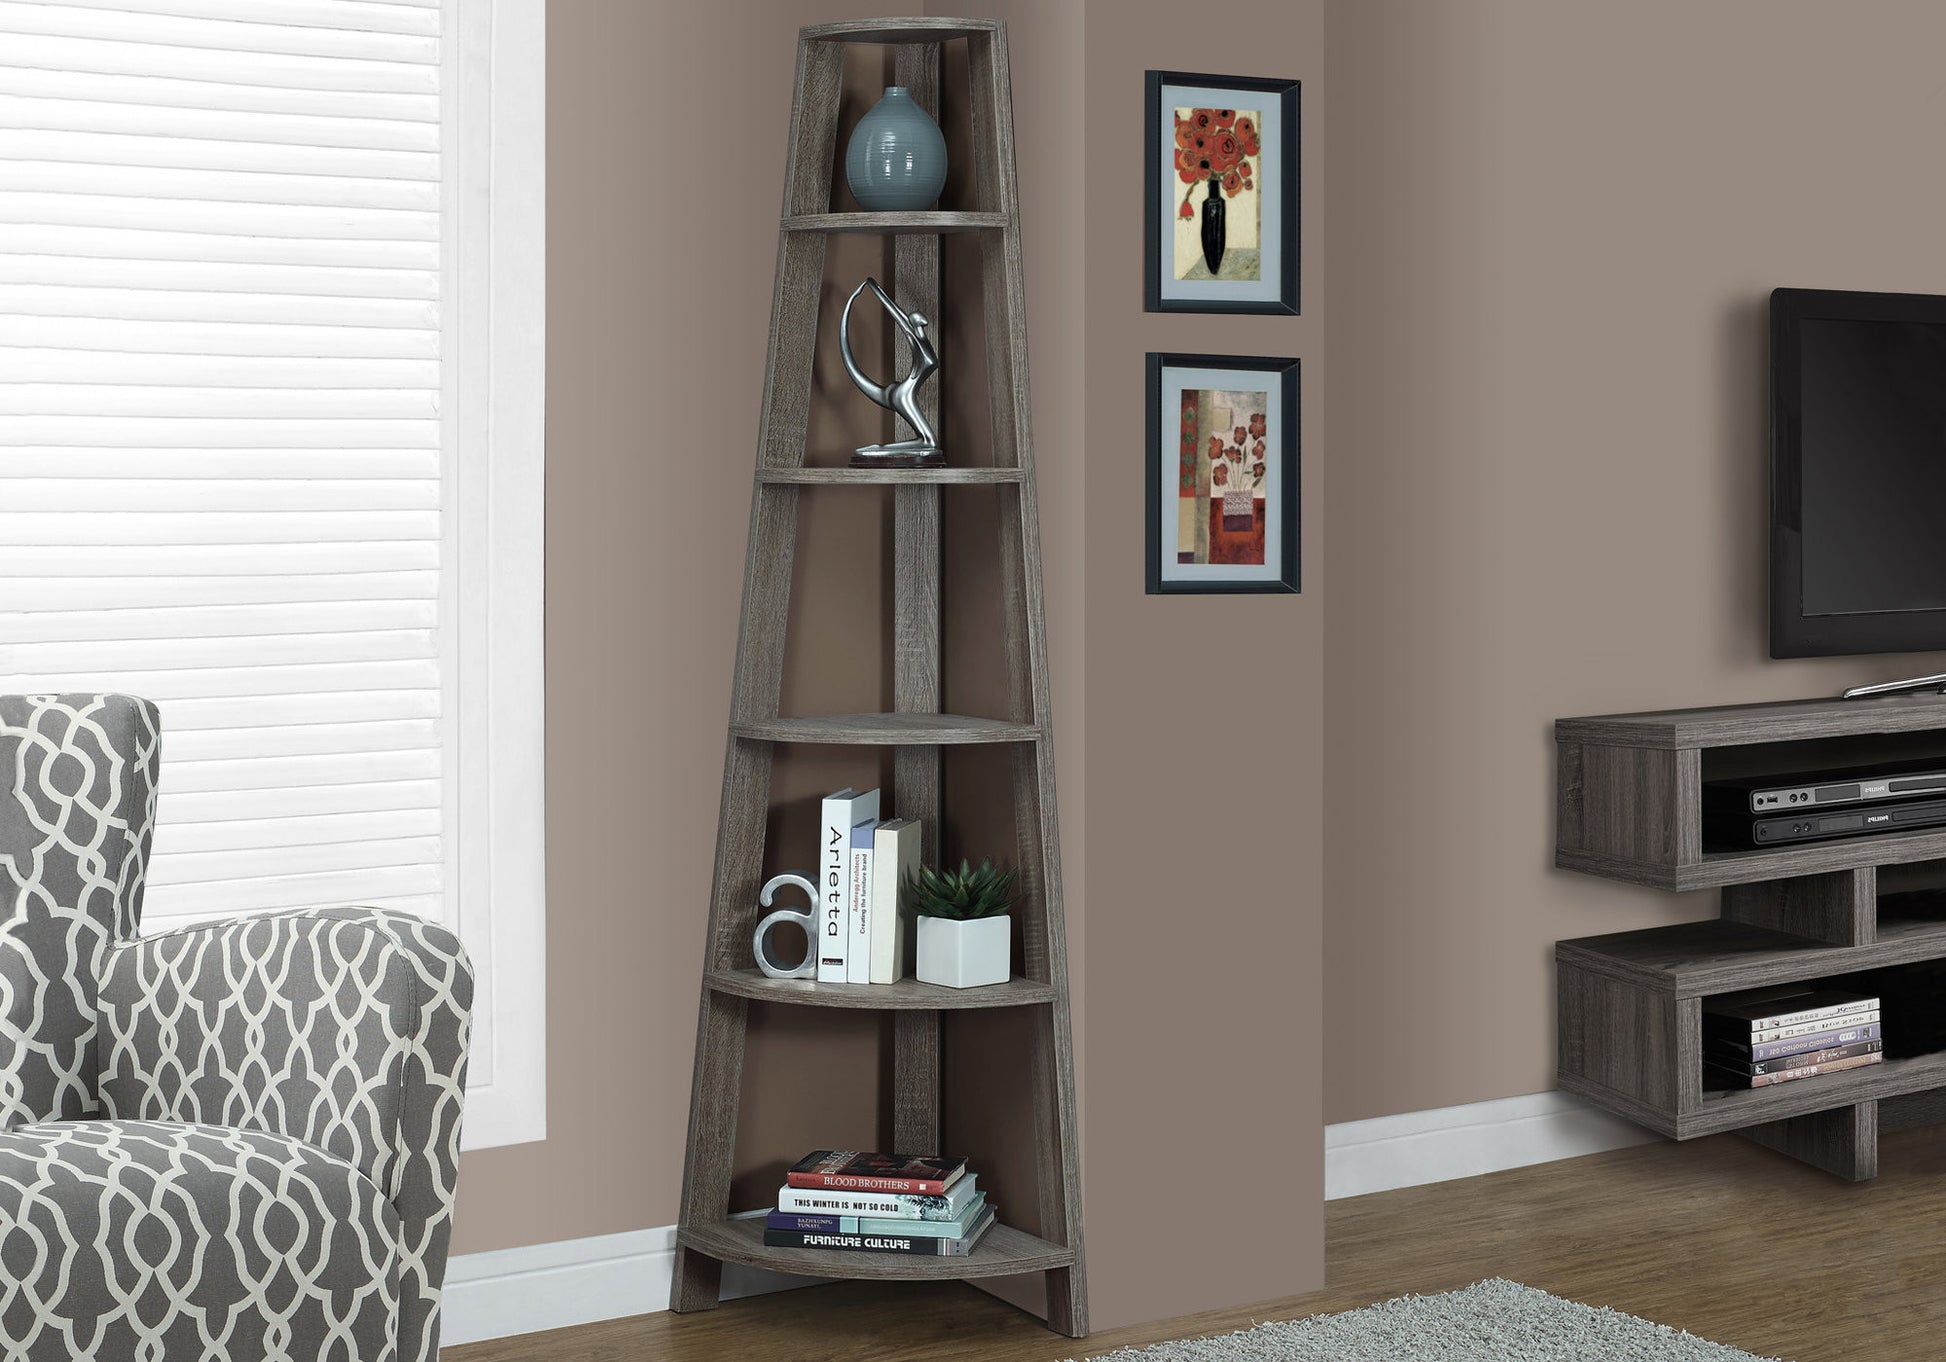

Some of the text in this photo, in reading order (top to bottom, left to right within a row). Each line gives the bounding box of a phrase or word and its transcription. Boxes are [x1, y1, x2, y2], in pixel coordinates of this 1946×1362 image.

[828, 826, 842, 936] Arletta
[824, 1176, 857, 1188] BLOOD
[858, 1178, 910, 1191] BROTHERS
[794, 1199, 899, 1212] THIS WINTER IS NOT SO COLD
[864, 1238, 911, 1250] CULTURE
